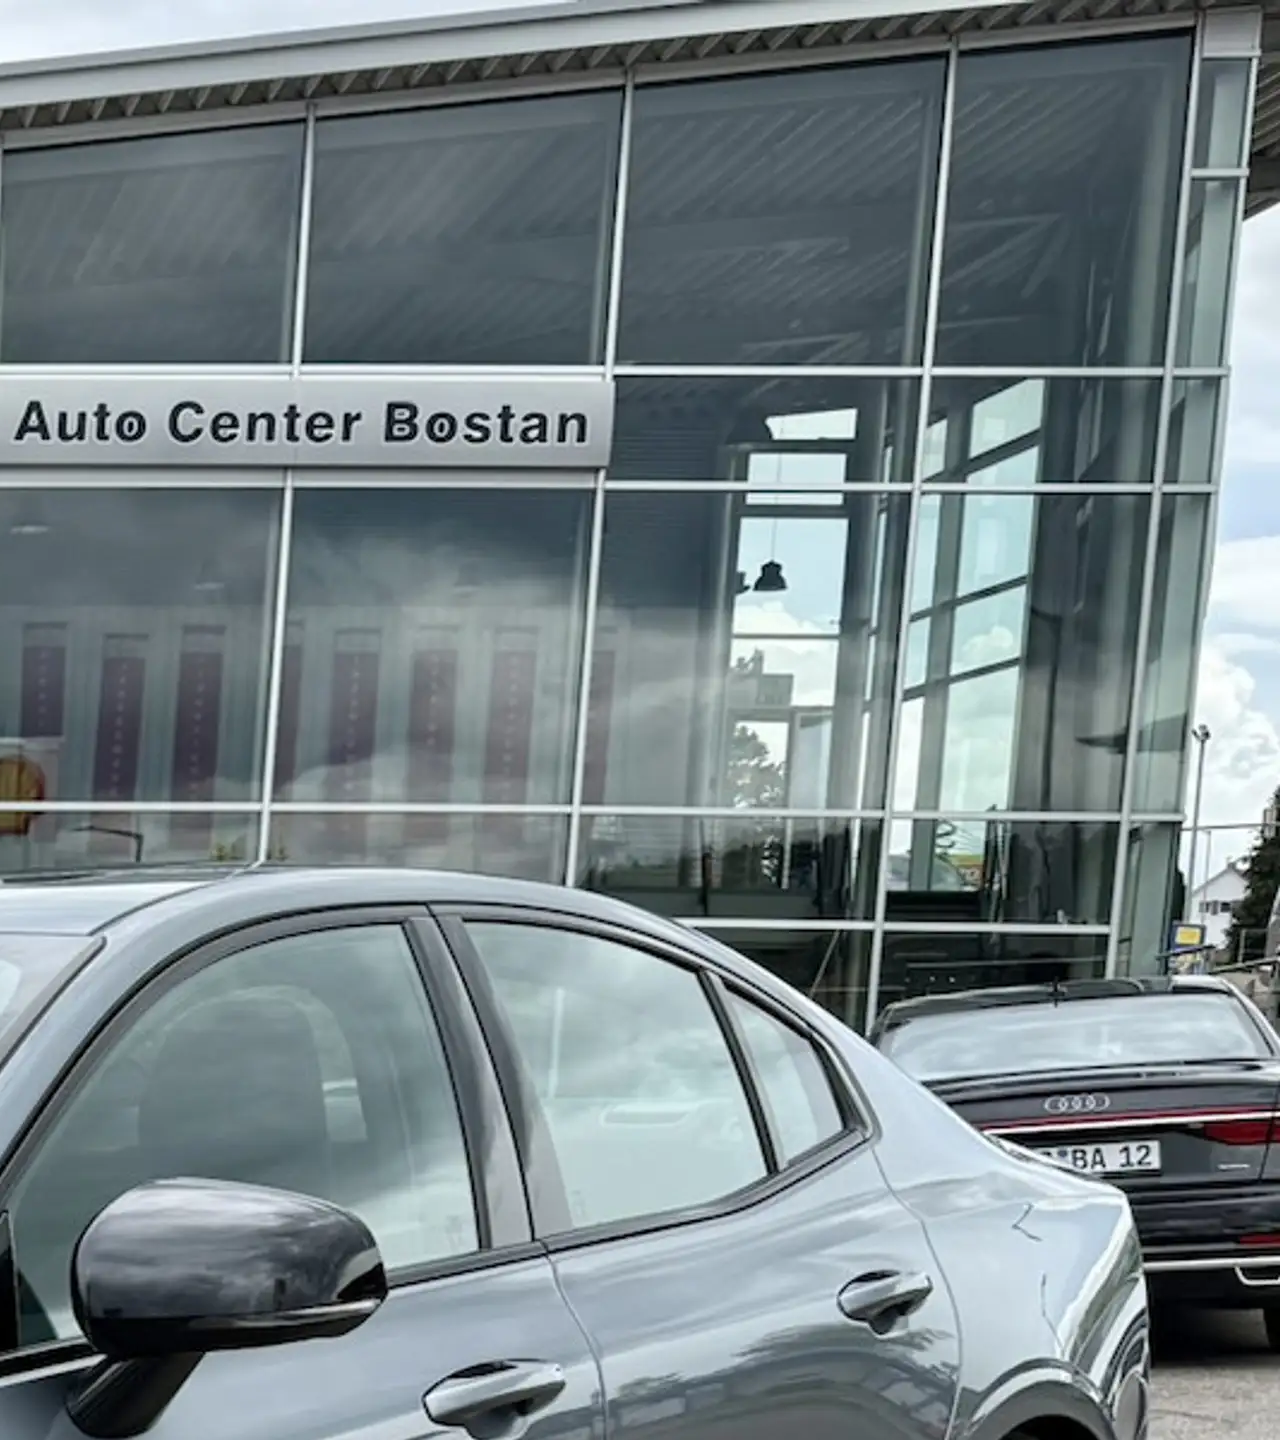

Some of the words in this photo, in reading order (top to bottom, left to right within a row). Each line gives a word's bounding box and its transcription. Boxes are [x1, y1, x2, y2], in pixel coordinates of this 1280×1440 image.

[13, 400, 148, 443] Auto
[167, 400, 362, 443] Center
[383, 401, 588, 444] Bostan
[1071, 1147, 1107, 1170] BA
[1119, 1143, 1153, 1168] 12
